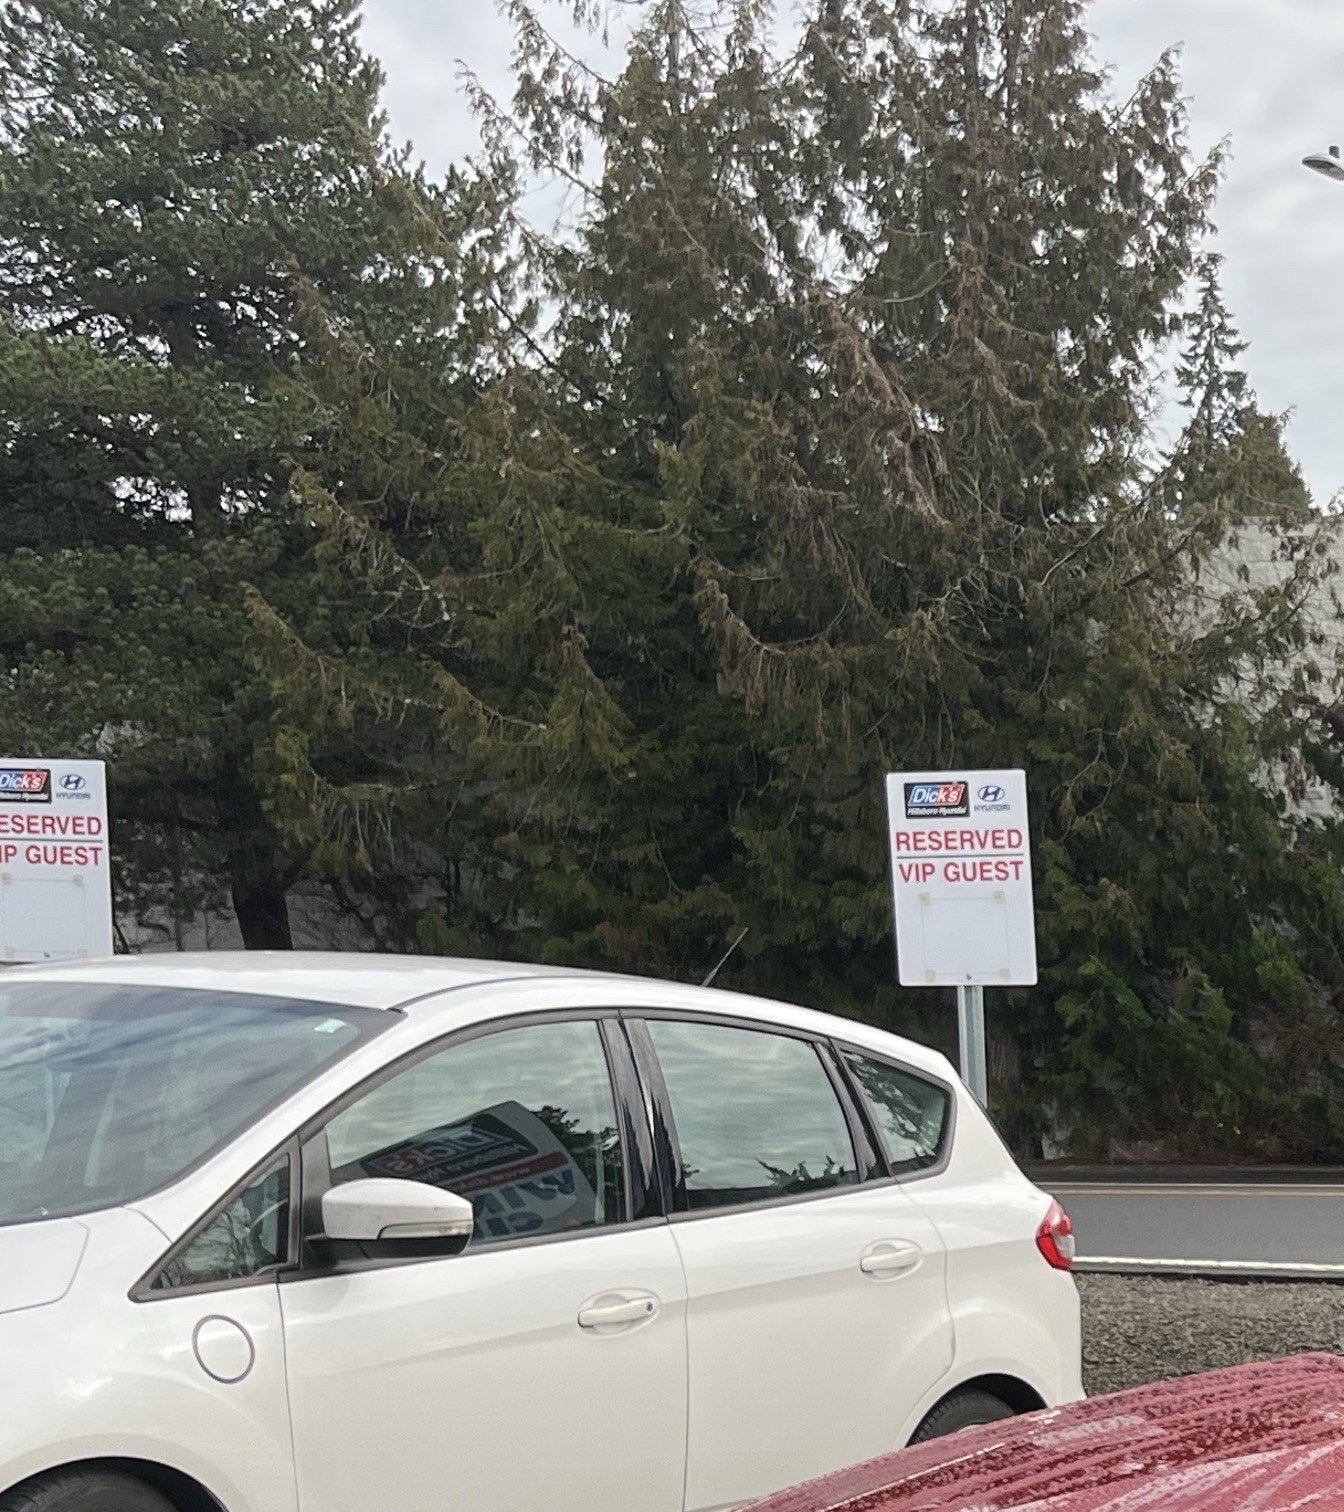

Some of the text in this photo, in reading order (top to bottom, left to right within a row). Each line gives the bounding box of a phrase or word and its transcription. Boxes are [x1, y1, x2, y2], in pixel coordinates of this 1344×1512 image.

[0, 814, 102, 836] ESERVED
[895, 828, 1023, 852] RESERVED
[25, 844, 103, 866] GUEST
[898, 860, 1024, 883] VIP GUEST
